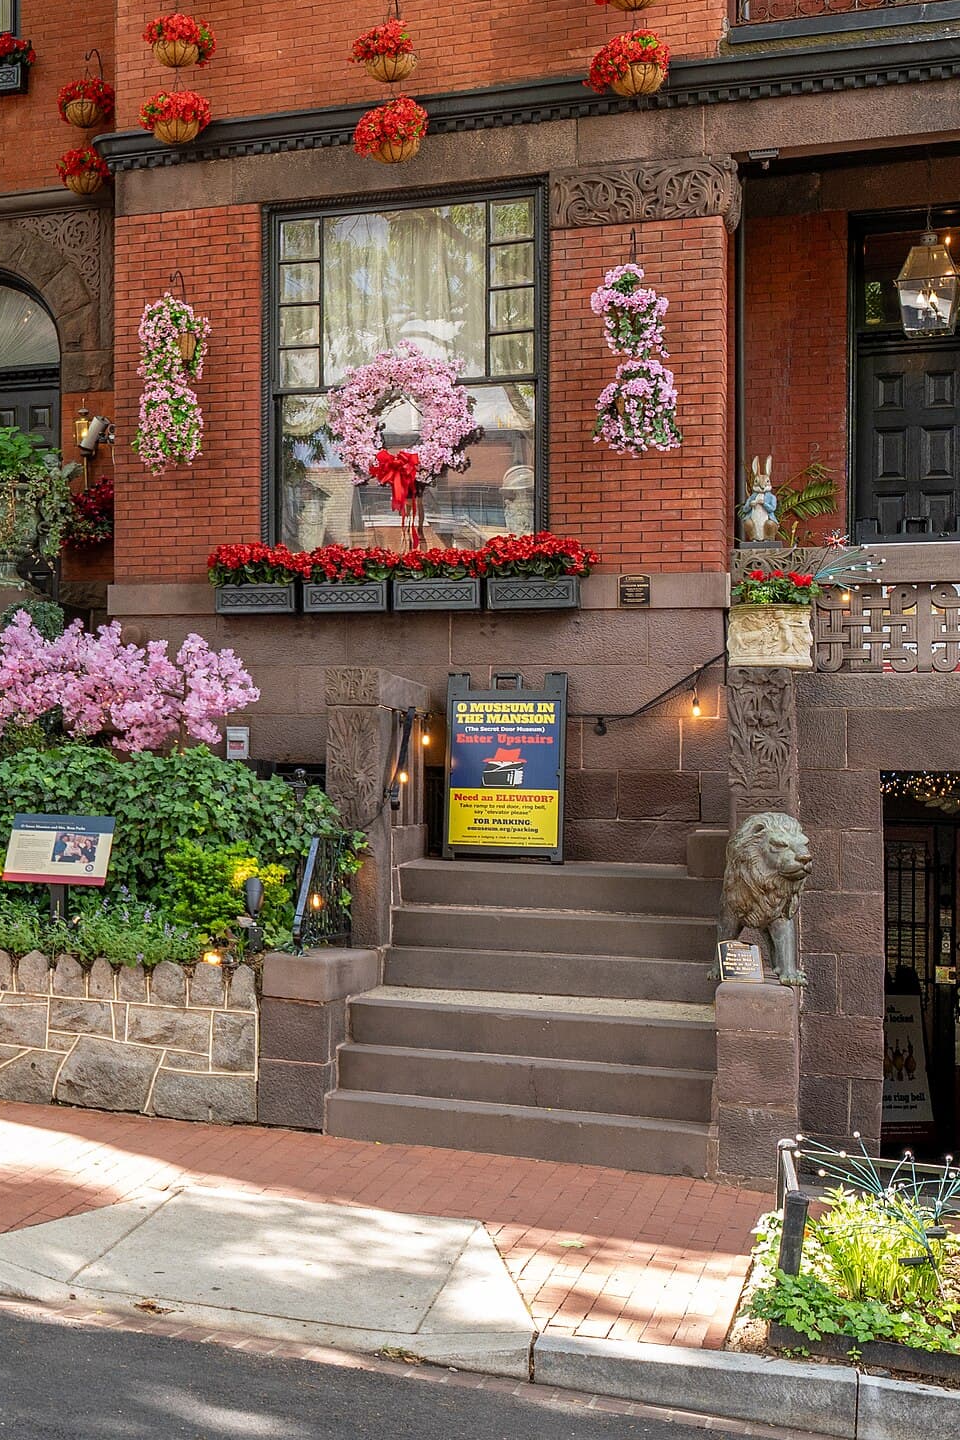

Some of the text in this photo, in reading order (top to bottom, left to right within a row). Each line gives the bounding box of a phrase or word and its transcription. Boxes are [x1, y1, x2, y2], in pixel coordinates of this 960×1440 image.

[457, 703, 555, 713] O MUSEUM IN
[456, 714, 555, 724] THE MANSION
[456, 733, 553, 746] Enter Upstairs
[454, 793, 478, 801] Need
[496, 794, 554, 803] ELEVATOR?
[893, 1092, 910, 1104] ring
[911, 1092, 925, 1101] bell
